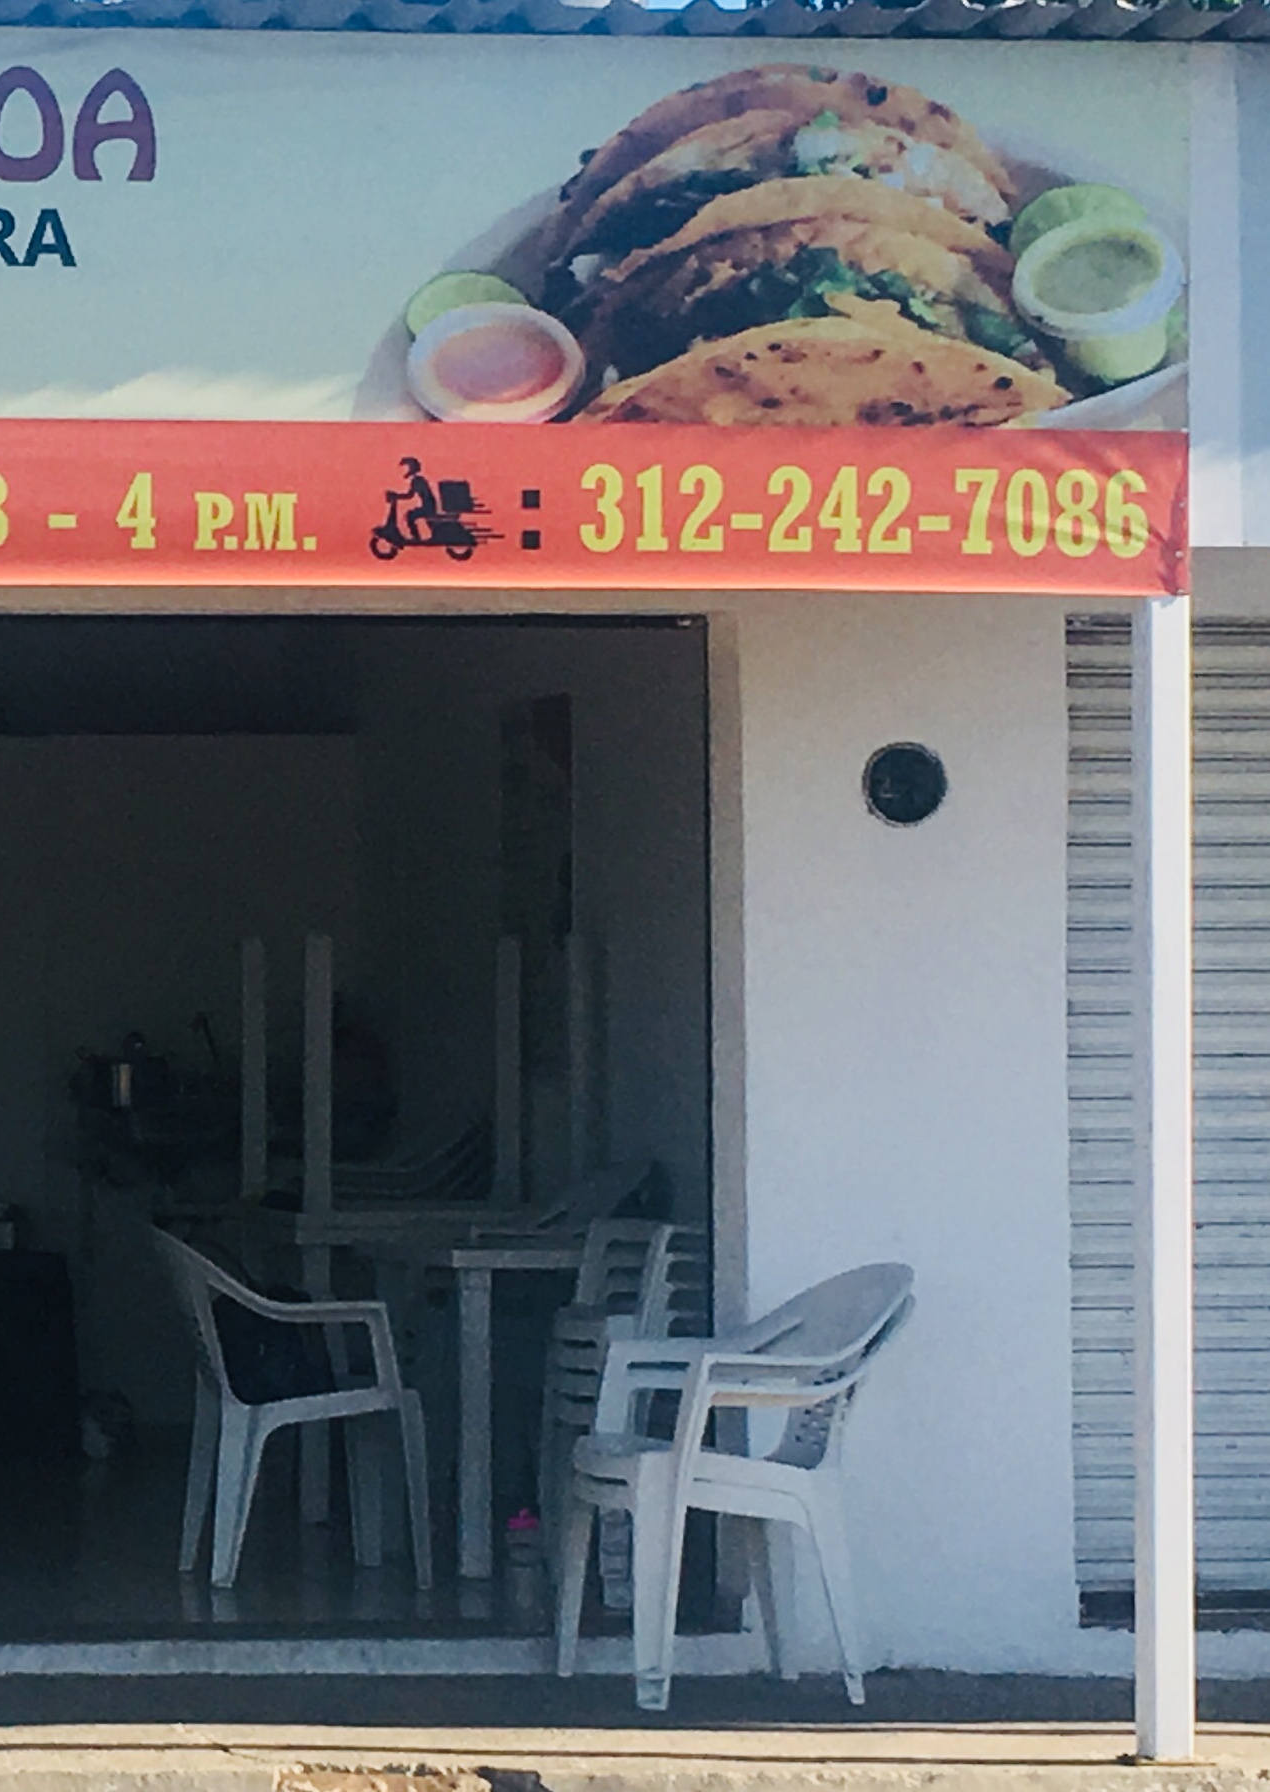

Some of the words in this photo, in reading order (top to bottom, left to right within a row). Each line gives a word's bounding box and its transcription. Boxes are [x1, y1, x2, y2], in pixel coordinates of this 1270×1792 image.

[47, 512, 78, 530] -
[116, 471, 157, 551] 4
[193, 491, 318, 552] P.M.
[578, 462, 1151, 560] 312-242-7086
